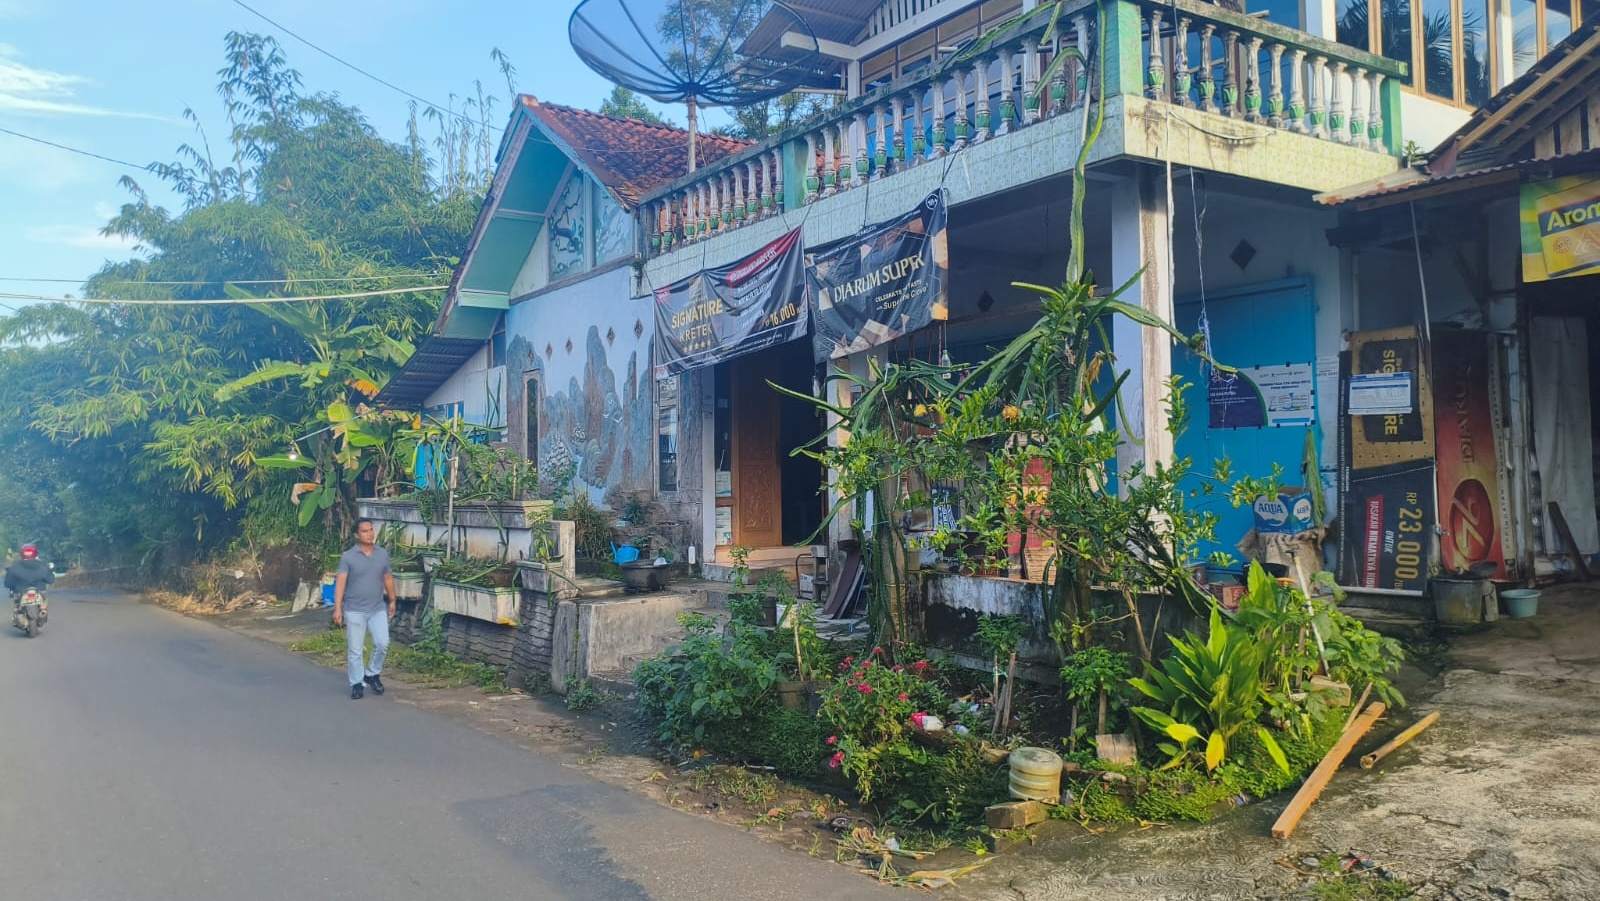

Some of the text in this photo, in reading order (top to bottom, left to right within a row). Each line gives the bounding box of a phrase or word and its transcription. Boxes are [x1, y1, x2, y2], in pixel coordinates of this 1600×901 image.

[672, 298, 723, 329] SIGNATURE
[680, 322, 713, 342] KRETEK
[1258, 502, 1284, 515] AQUA
[1383, 530, 1395, 554] UNTUK
[1394, 507, 1423, 580] 23.000
